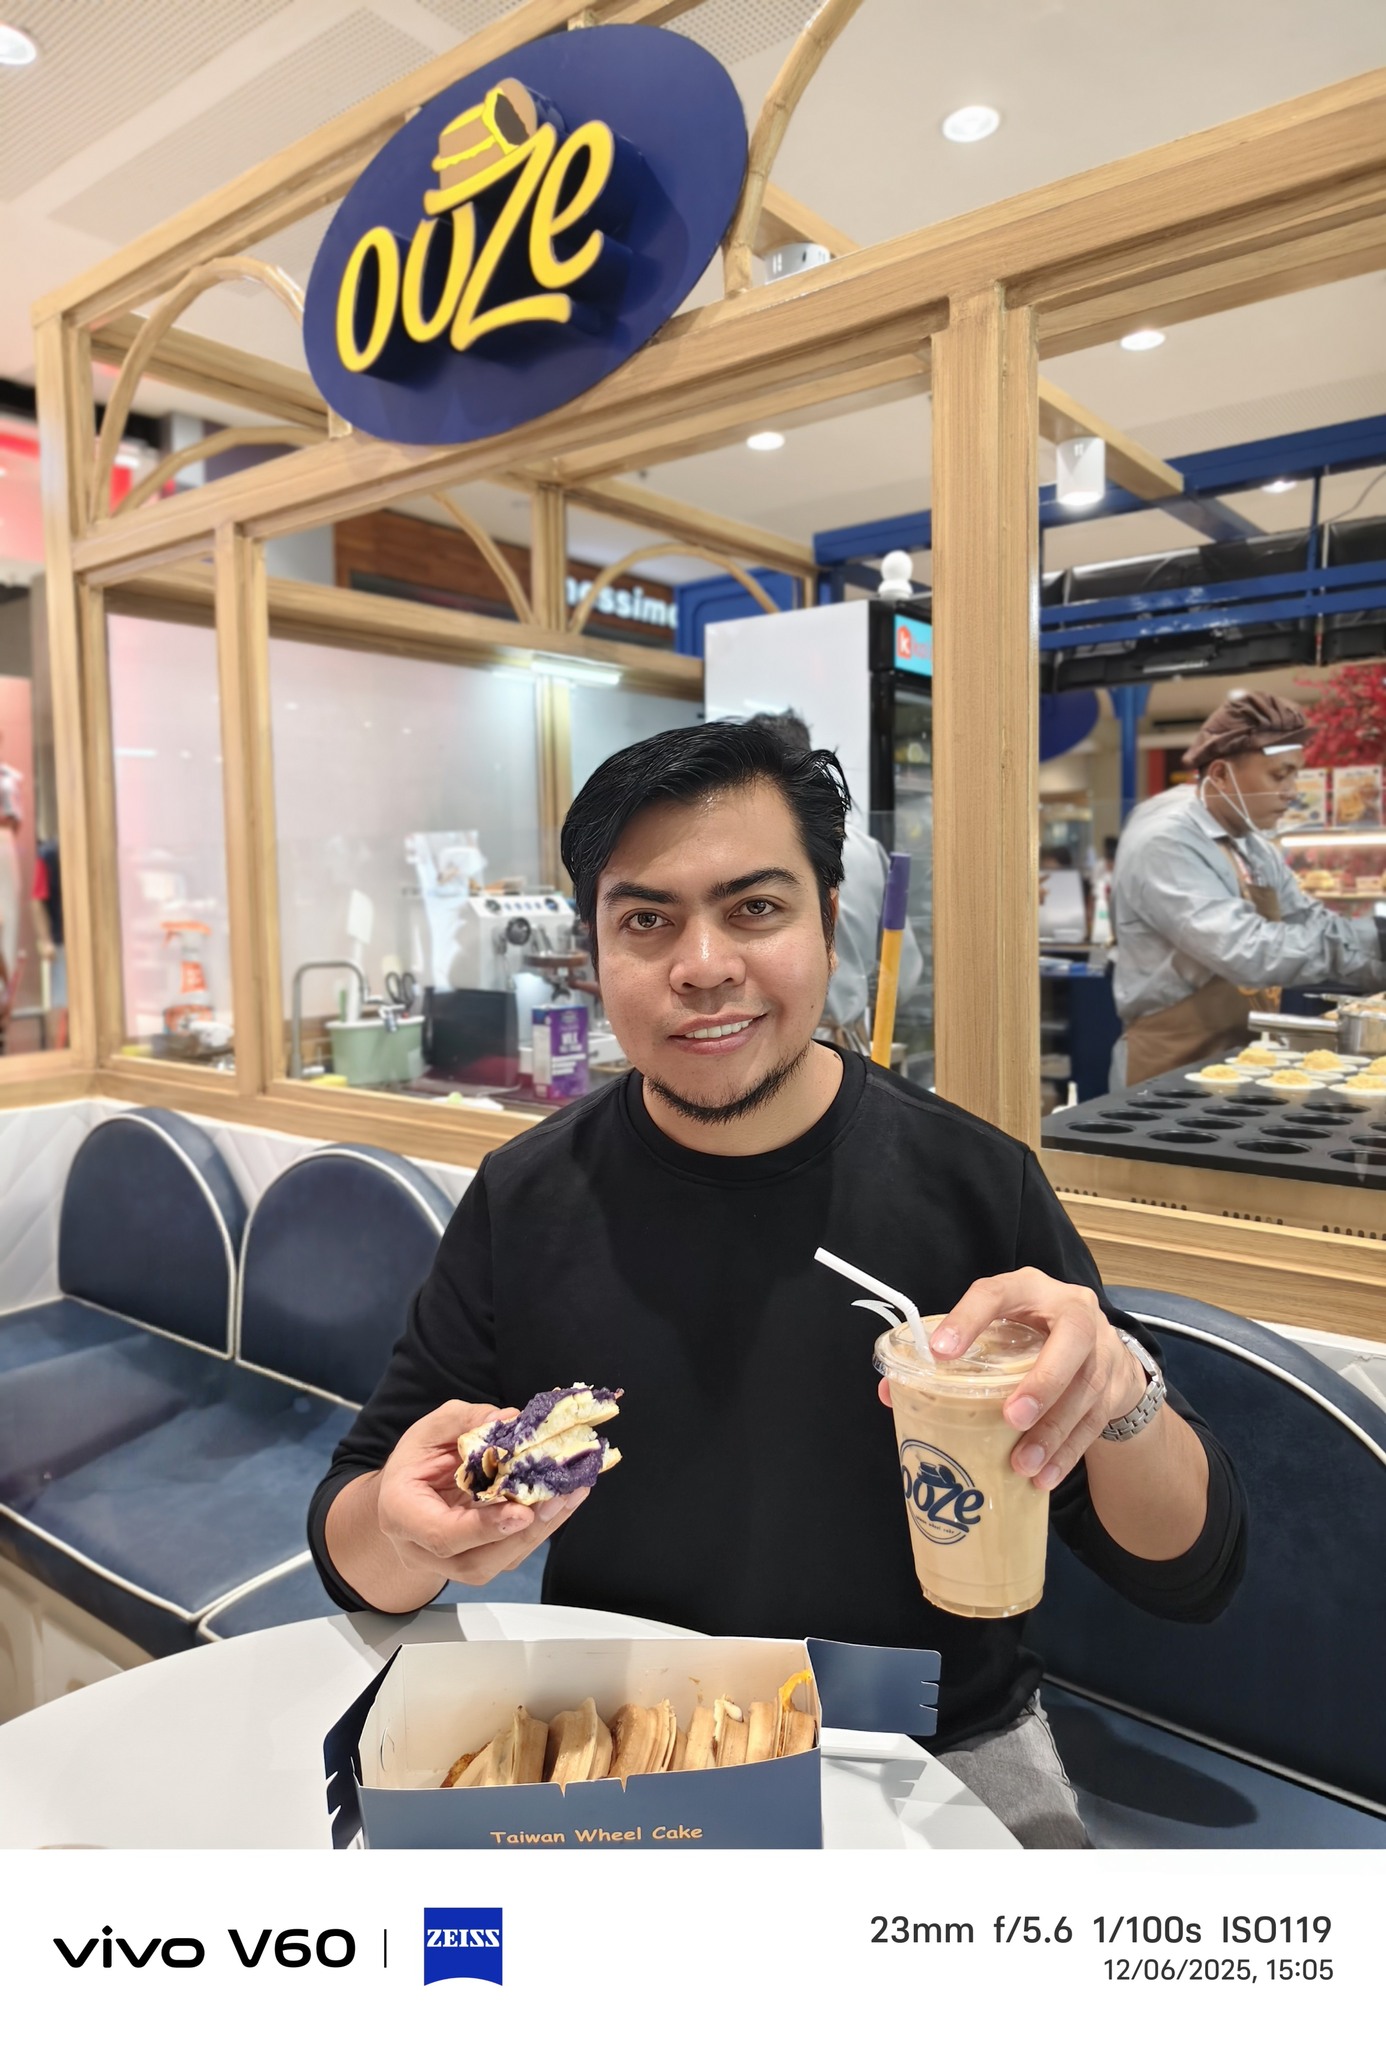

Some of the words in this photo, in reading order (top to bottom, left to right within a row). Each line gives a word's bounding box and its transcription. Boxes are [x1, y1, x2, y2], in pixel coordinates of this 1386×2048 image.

[489, 1831, 566, 1844] Taiwan
[574, 1826, 643, 1843] Wheel
[652, 1824, 704, 1840] Cake
